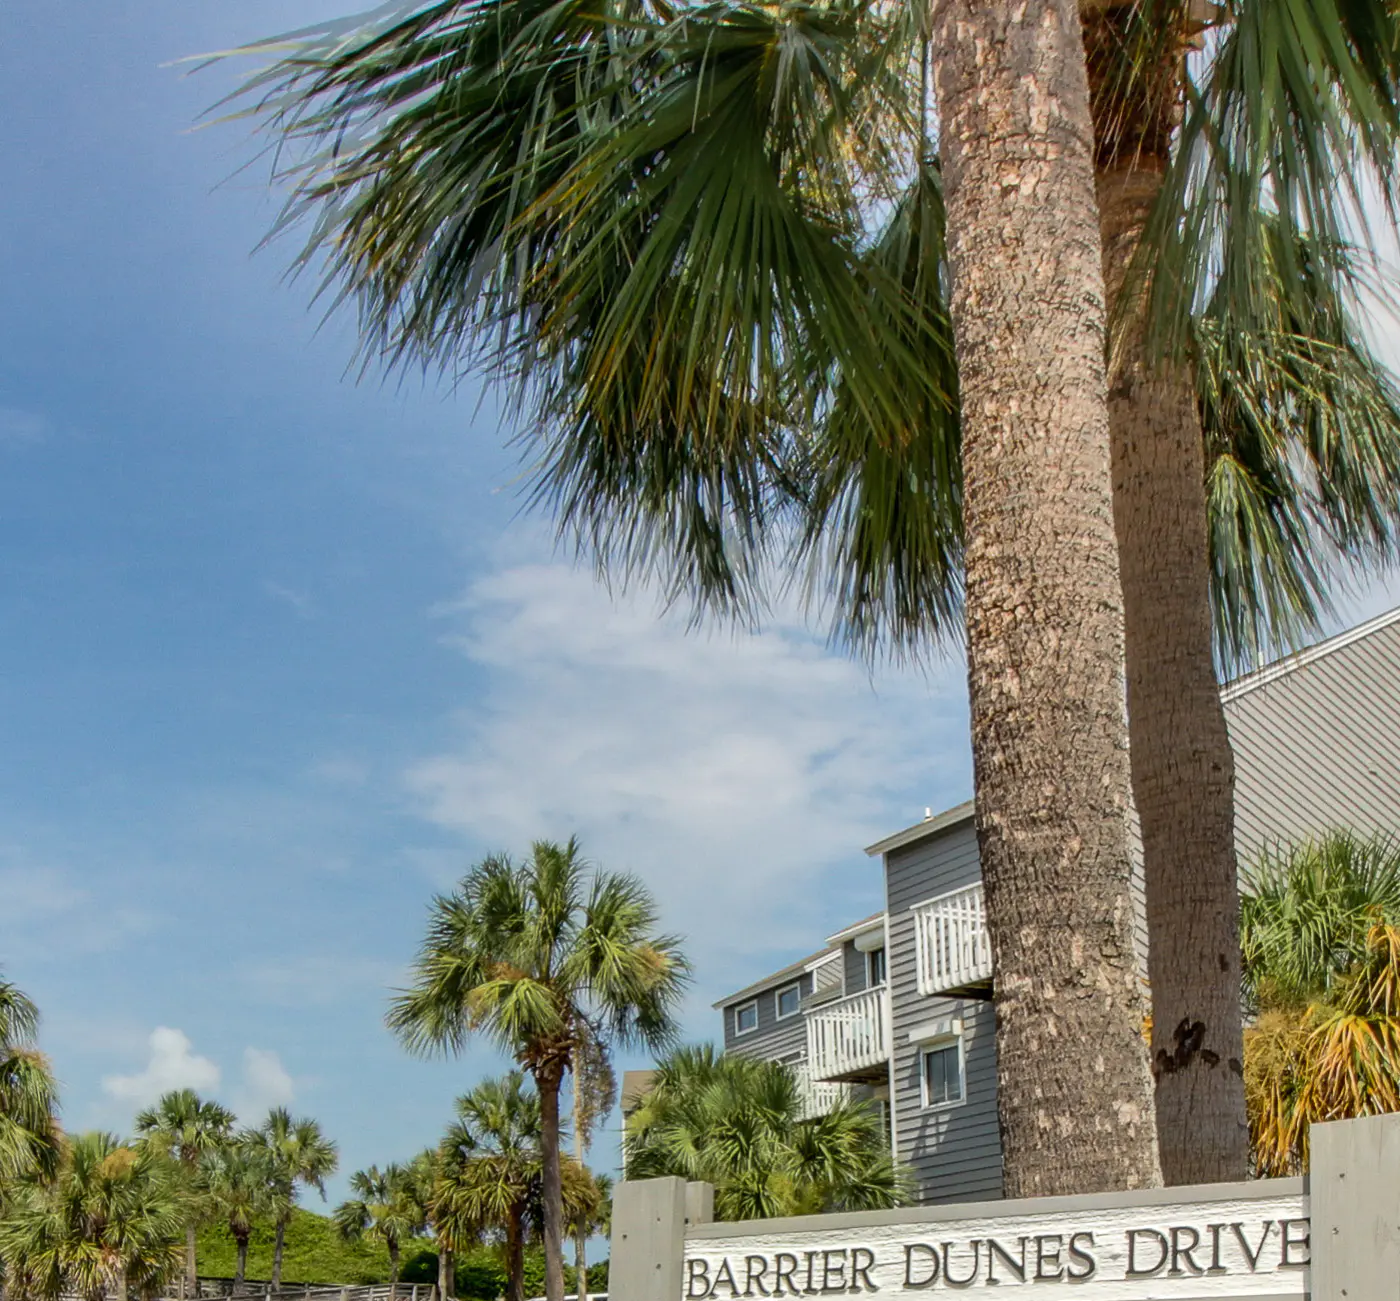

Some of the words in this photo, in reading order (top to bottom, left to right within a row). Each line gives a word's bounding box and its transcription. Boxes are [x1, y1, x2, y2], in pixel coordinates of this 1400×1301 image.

[685, 1247, 878, 1300] BARRIER
[903, 1231, 1096, 1290] DUNES
[1125, 1218, 1311, 1278] DRIVE
